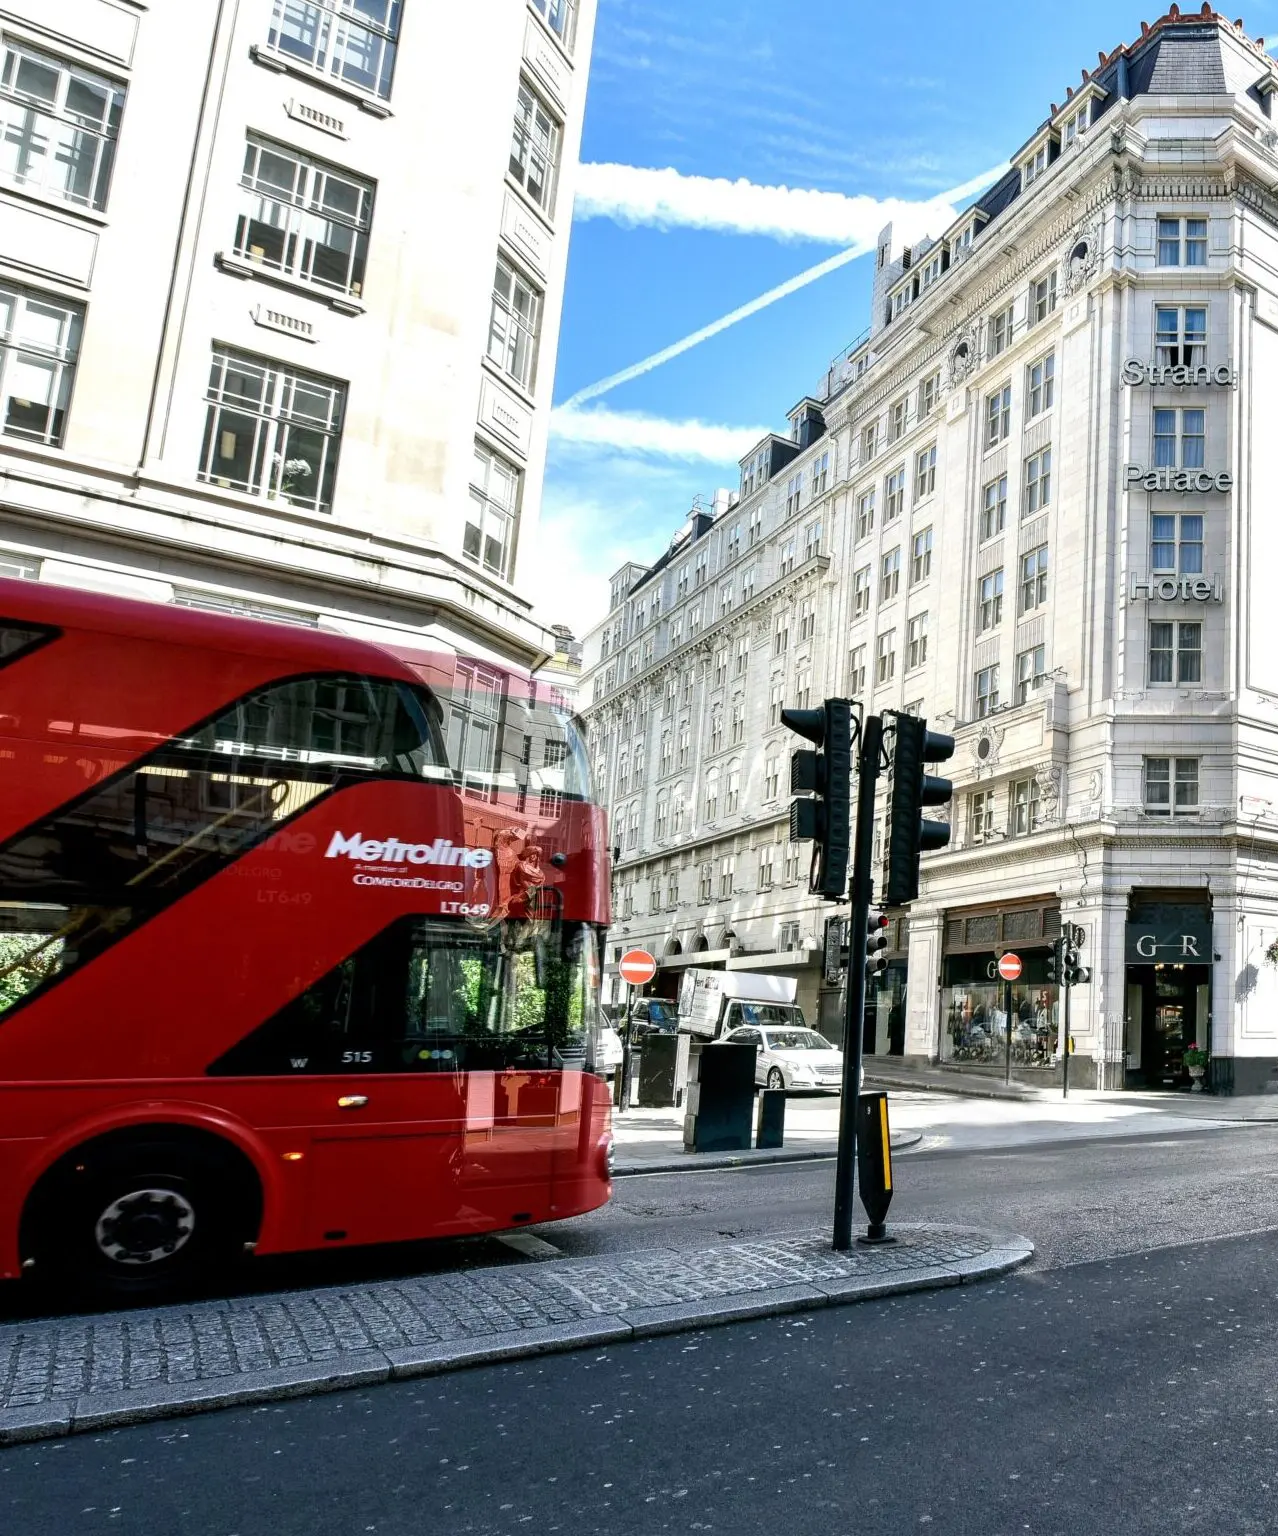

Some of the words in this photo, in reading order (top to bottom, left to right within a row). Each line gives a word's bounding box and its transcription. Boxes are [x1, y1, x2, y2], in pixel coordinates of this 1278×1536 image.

[1122, 358, 1233, 386] Strand
[1123, 464, 1233, 493] Palace
[1130, 572, 1222, 601] Hotel
[324, 831, 493, 868] Metroline
[440, 901, 490, 915] LT649
[341, 1051, 372, 1062] 515
